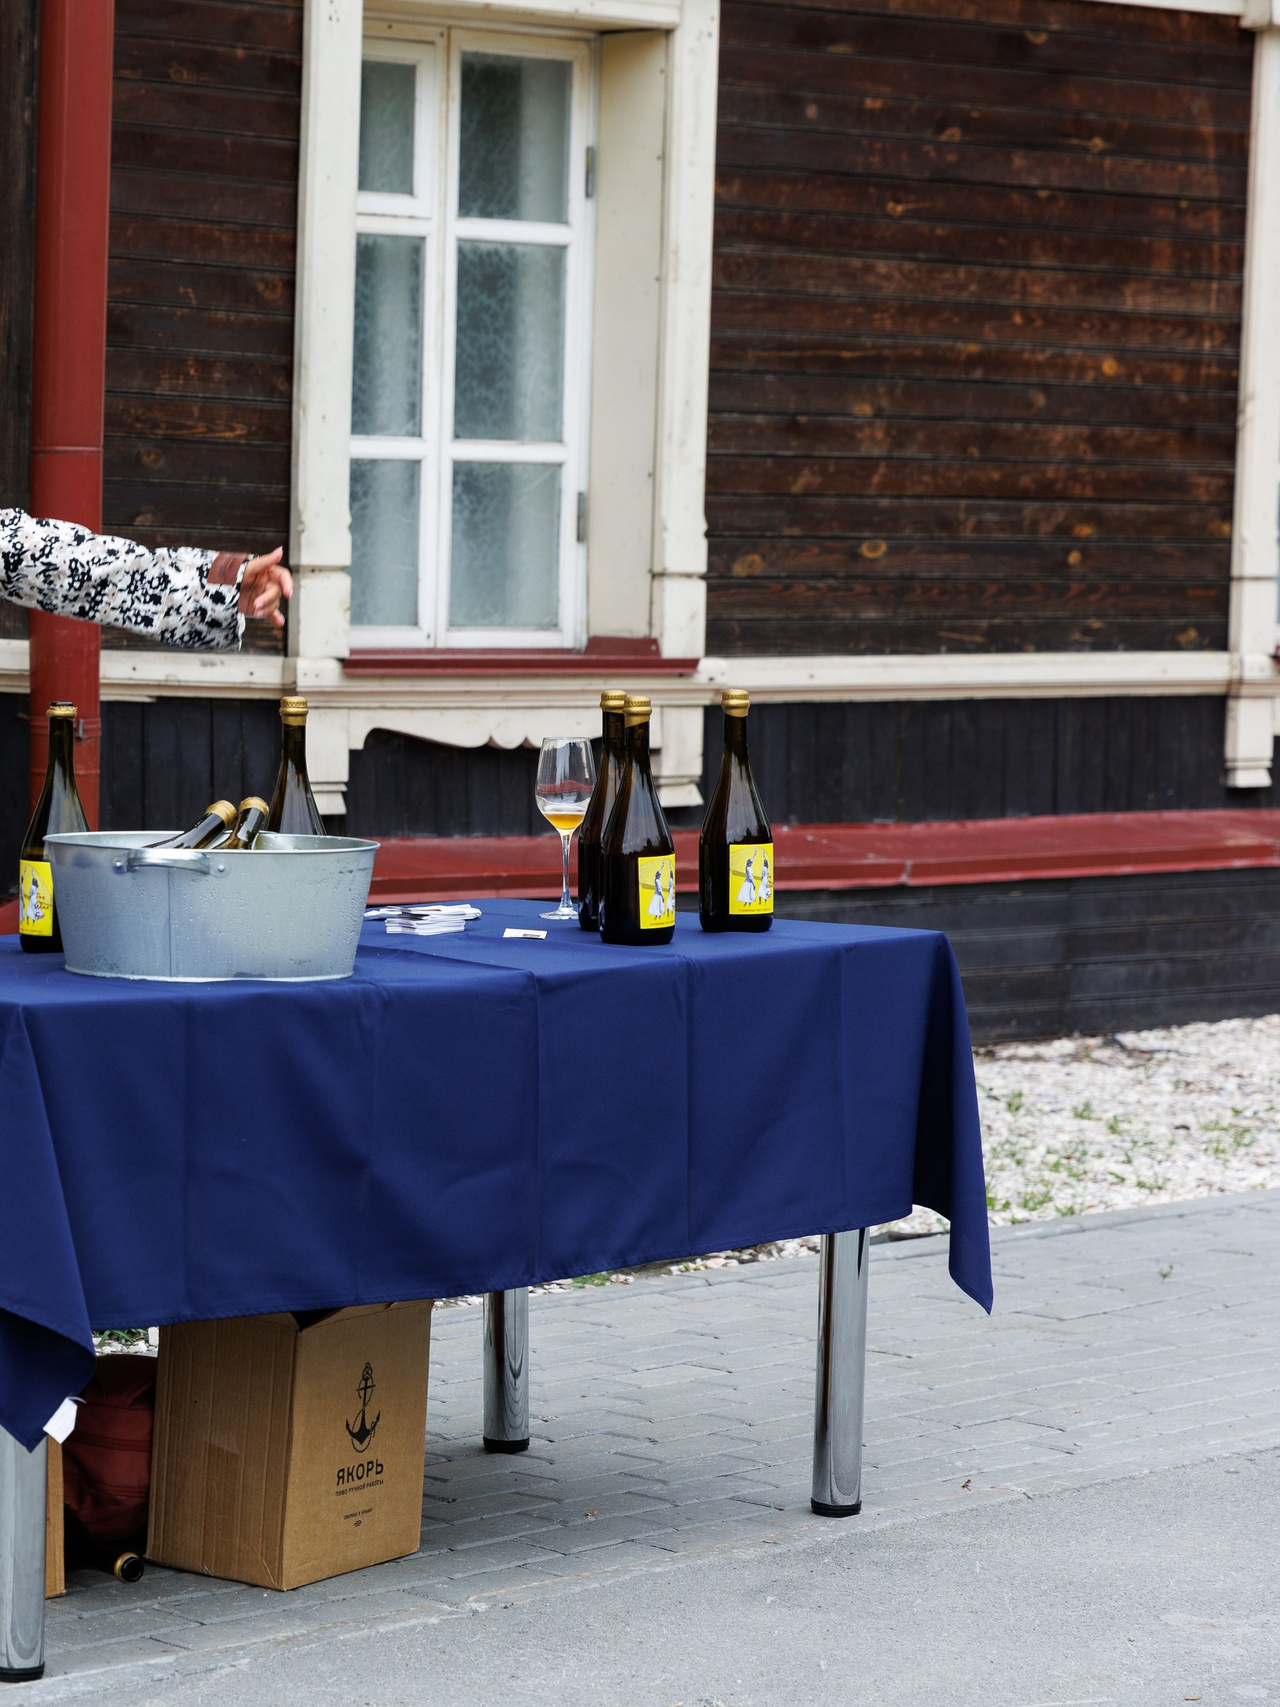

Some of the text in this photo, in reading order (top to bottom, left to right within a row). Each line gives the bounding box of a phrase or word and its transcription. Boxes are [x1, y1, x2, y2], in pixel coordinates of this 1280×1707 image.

[336, 1459, 384, 1486] ЯКОРЬ
[348, 1483, 366, 1493] РУЧНОЙ
[366, 1479, 384, 1488] РАБОТЫ
